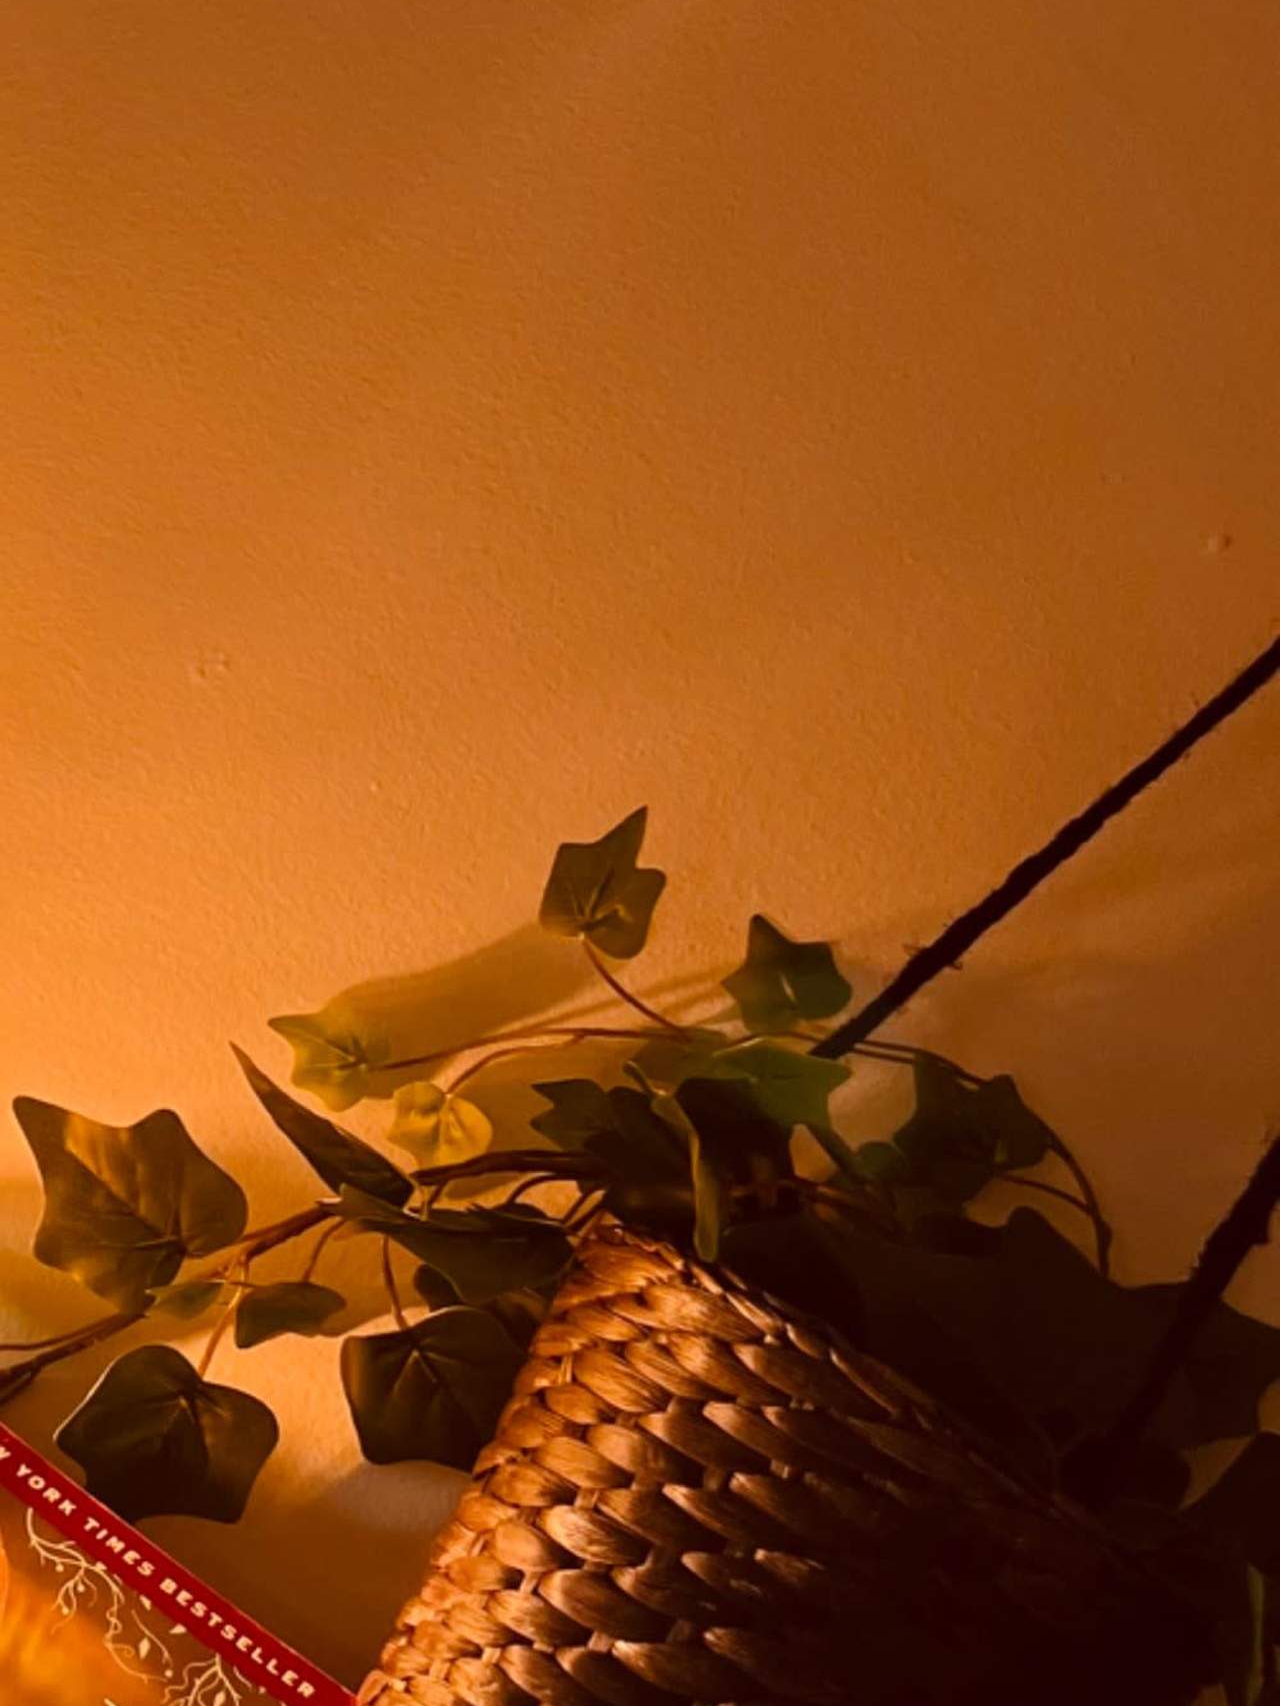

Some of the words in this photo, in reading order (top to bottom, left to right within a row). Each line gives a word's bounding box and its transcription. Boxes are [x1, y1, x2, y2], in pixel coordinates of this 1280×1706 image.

[18, 1464, 77, 1519] YORK
[81, 1517, 155, 1579] TIMES
[158, 1578, 316, 1700] BESTSELLER
